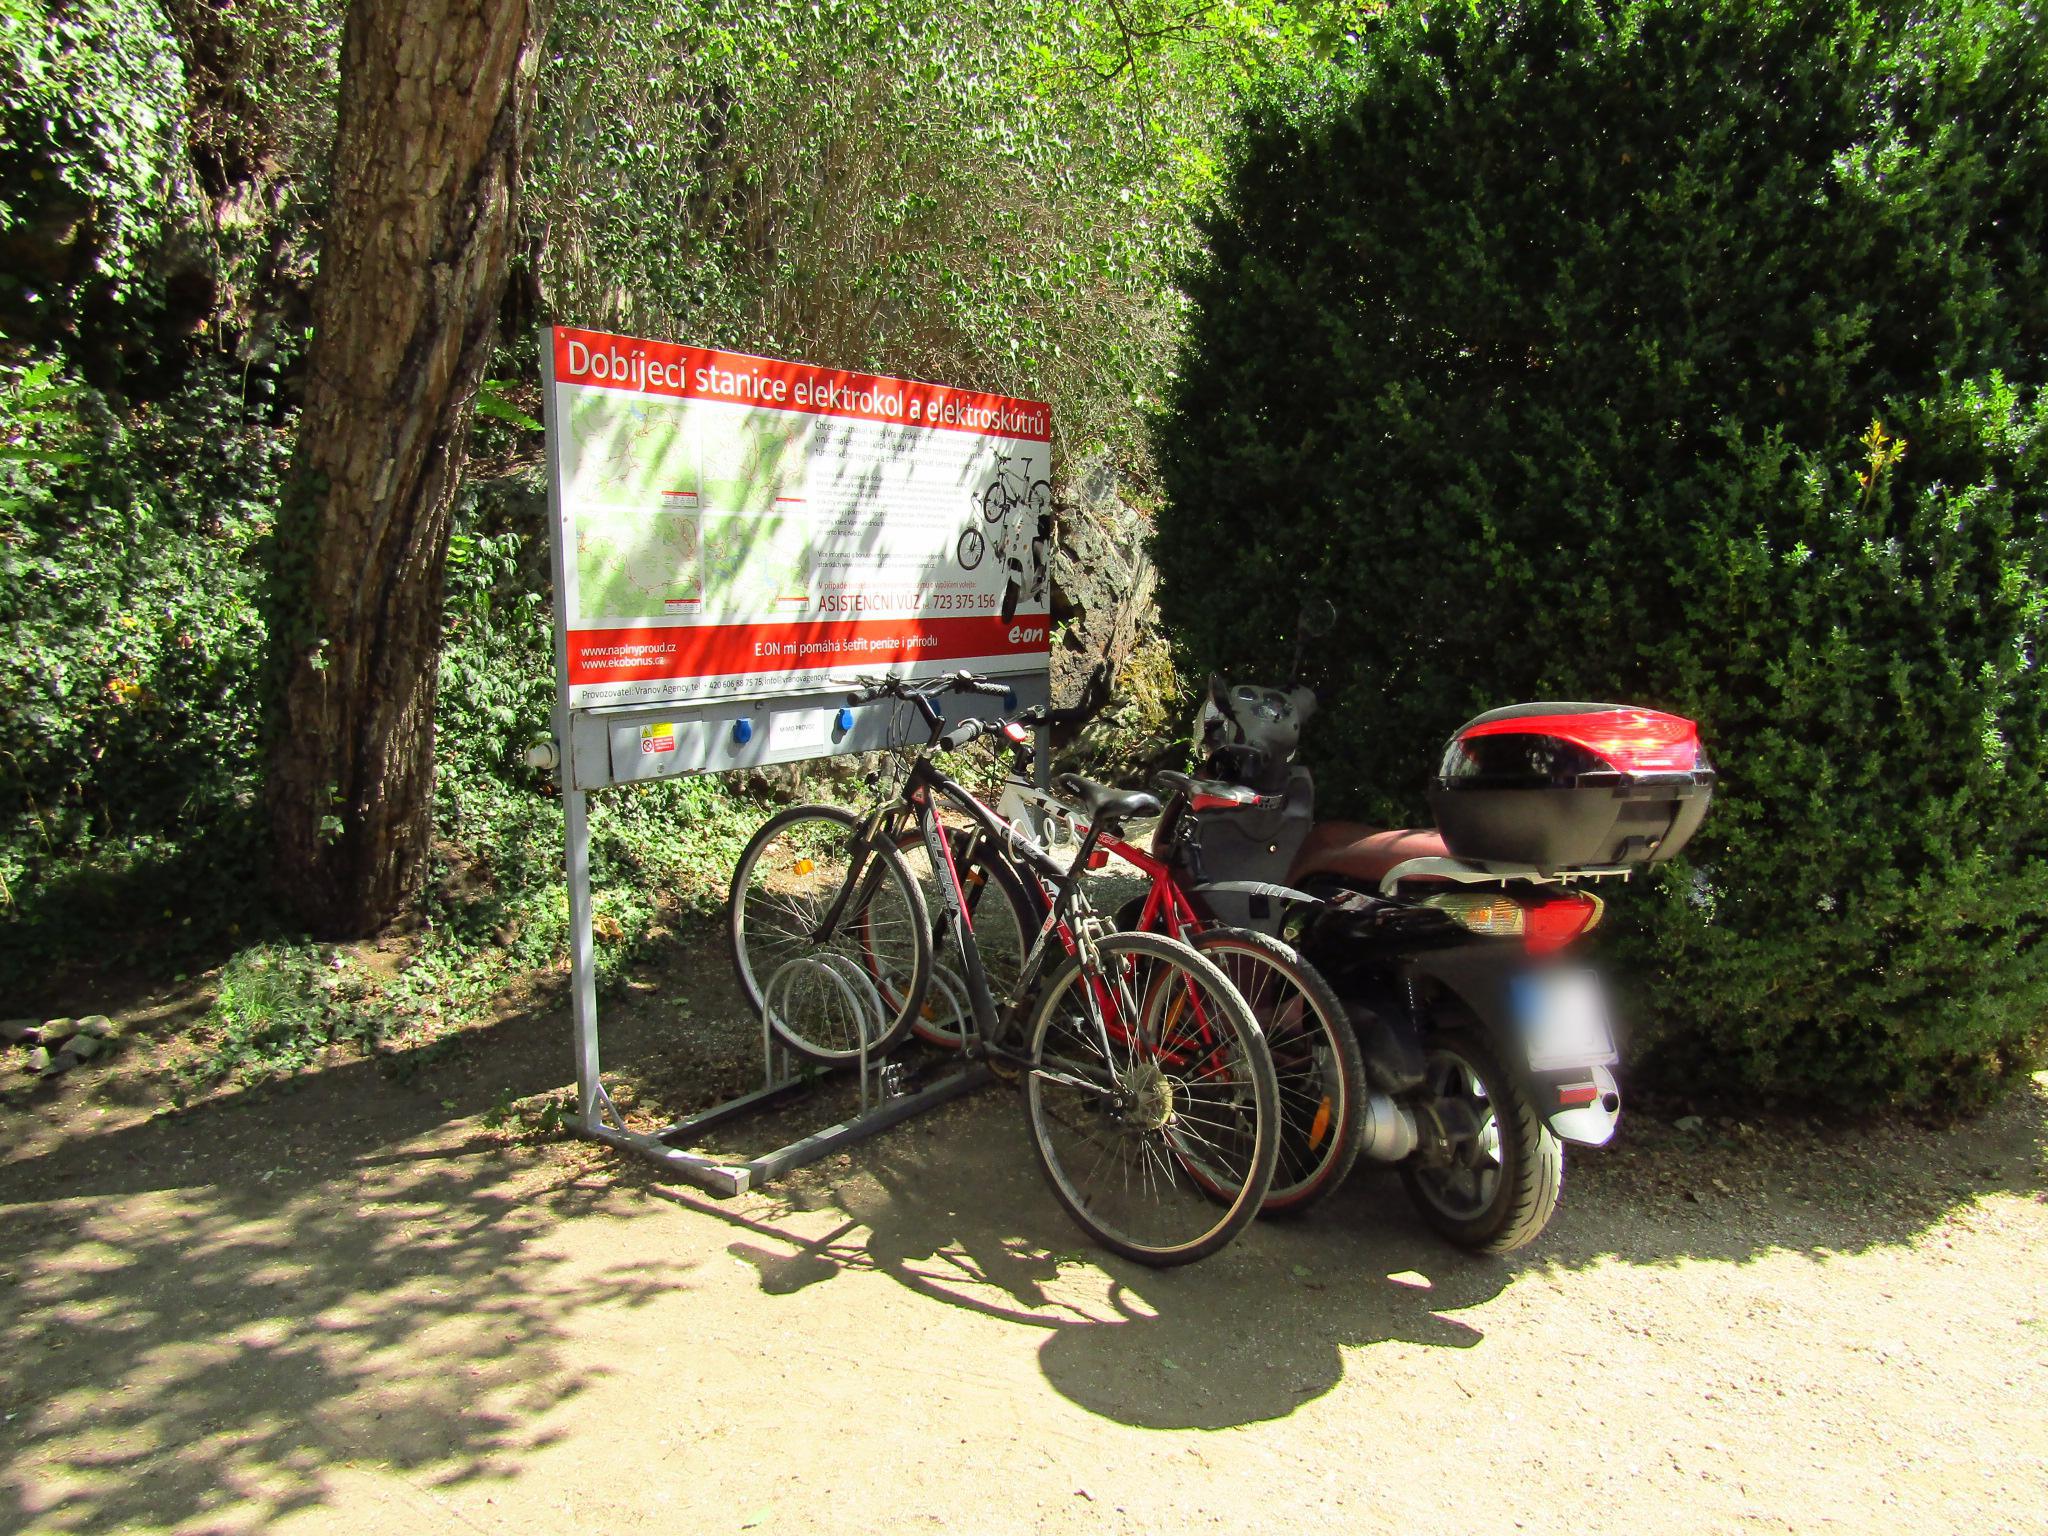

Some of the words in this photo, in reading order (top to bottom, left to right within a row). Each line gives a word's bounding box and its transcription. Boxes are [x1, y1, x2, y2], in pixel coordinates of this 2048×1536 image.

[568, 340, 686, 392] Dobíjecí
[695, 365, 787, 402] stanice
[794, 376, 903, 418] elektrokol
[909, 398, 921, 420] a
[927, 395, 1044, 436] elektroskútrů
[818, 590, 893, 612] ASISTENČNÍ
[933, 594, 952, 610] 723
[956, 594, 974, 609] 375
[978, 593, 996, 608] 156
[581, 642, 676, 657] www.naplnyproud.cz
[755, 642, 780, 657] E.ON
[784, 644, 796, 655] mi
[800, 641, 840, 656] pomáhá
[843, 639, 867, 651] šetřit
[870, 638, 900, 653] peníze
[907, 635, 938, 651] přírodu
[582, 656, 665, 669] www.ekobonus.cz
[582, 686, 634, 700] Provozovatel:
[635, 685, 661, 696] Vranov
[722, 679, 735, 688] 606
[736, 679, 743, 687] 88
